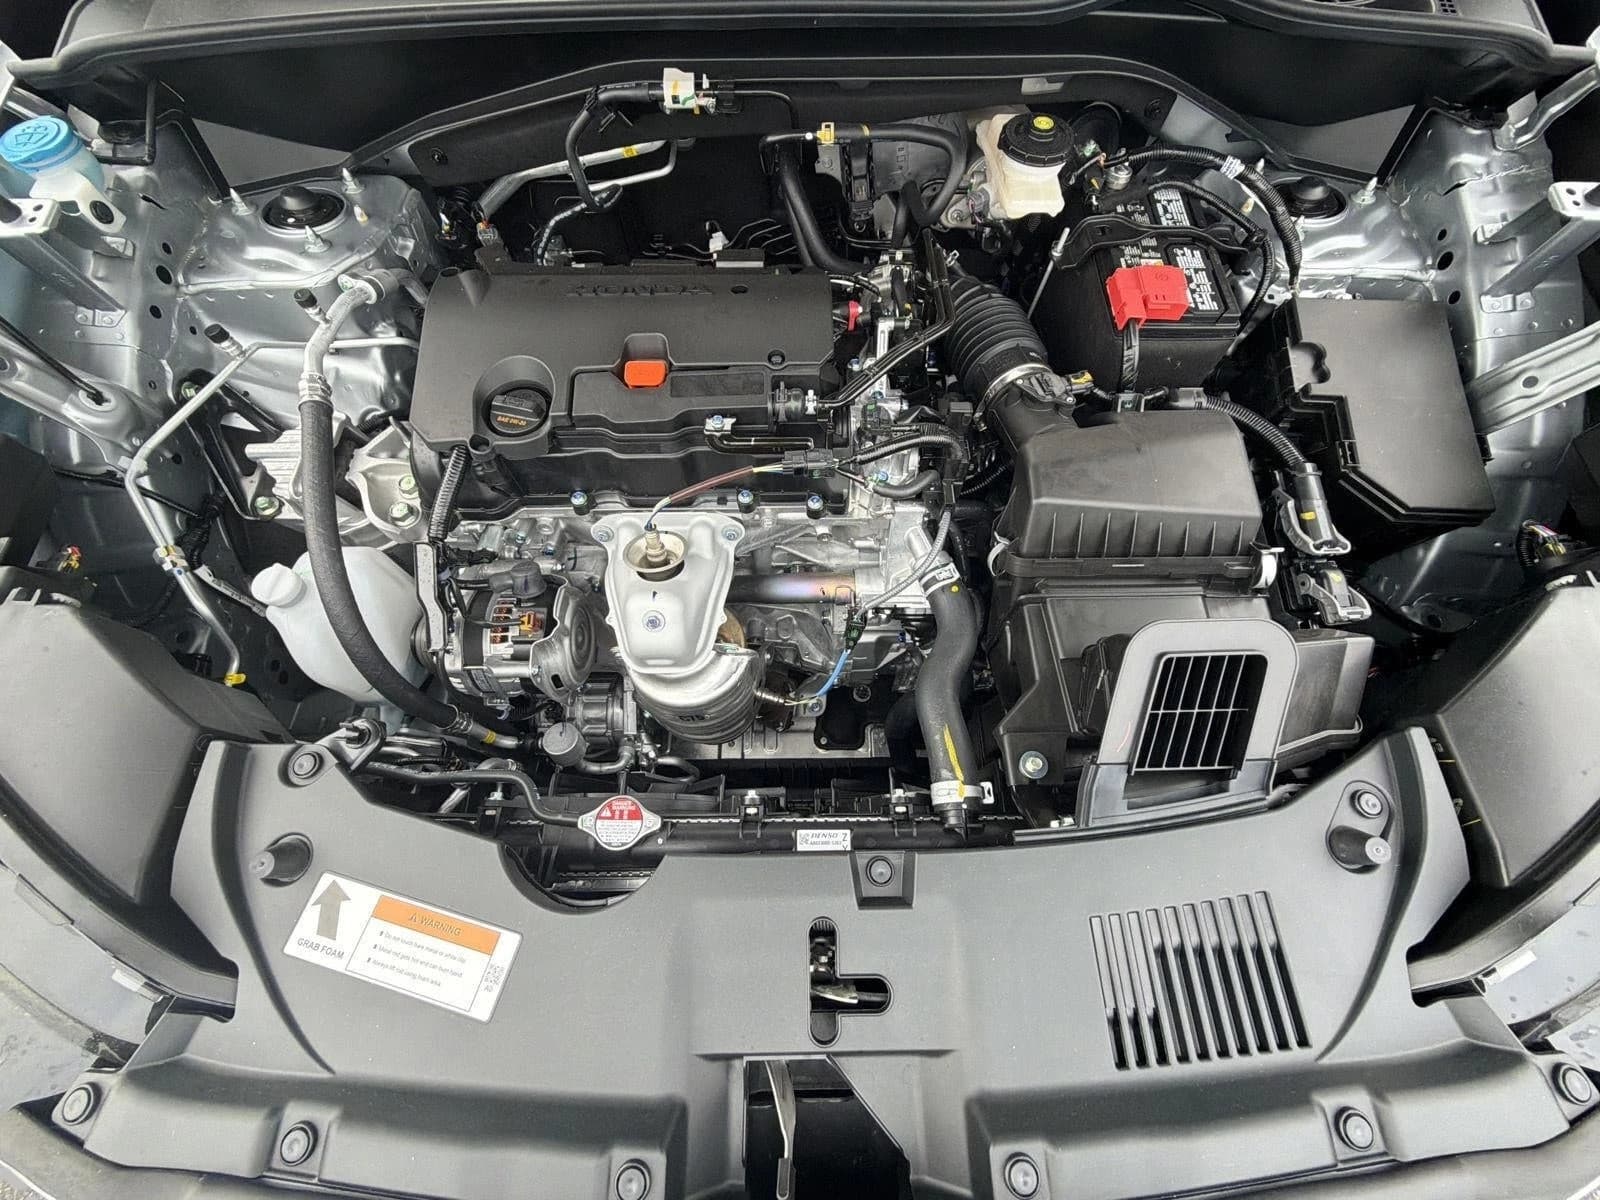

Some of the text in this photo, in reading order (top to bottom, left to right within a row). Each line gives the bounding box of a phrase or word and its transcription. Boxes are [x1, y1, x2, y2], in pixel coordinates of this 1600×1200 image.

[567, 285, 715, 297] HONDA
[421, 915, 461, 935] WARNING
[297, 937, 344, 958] GRAB FOAM
